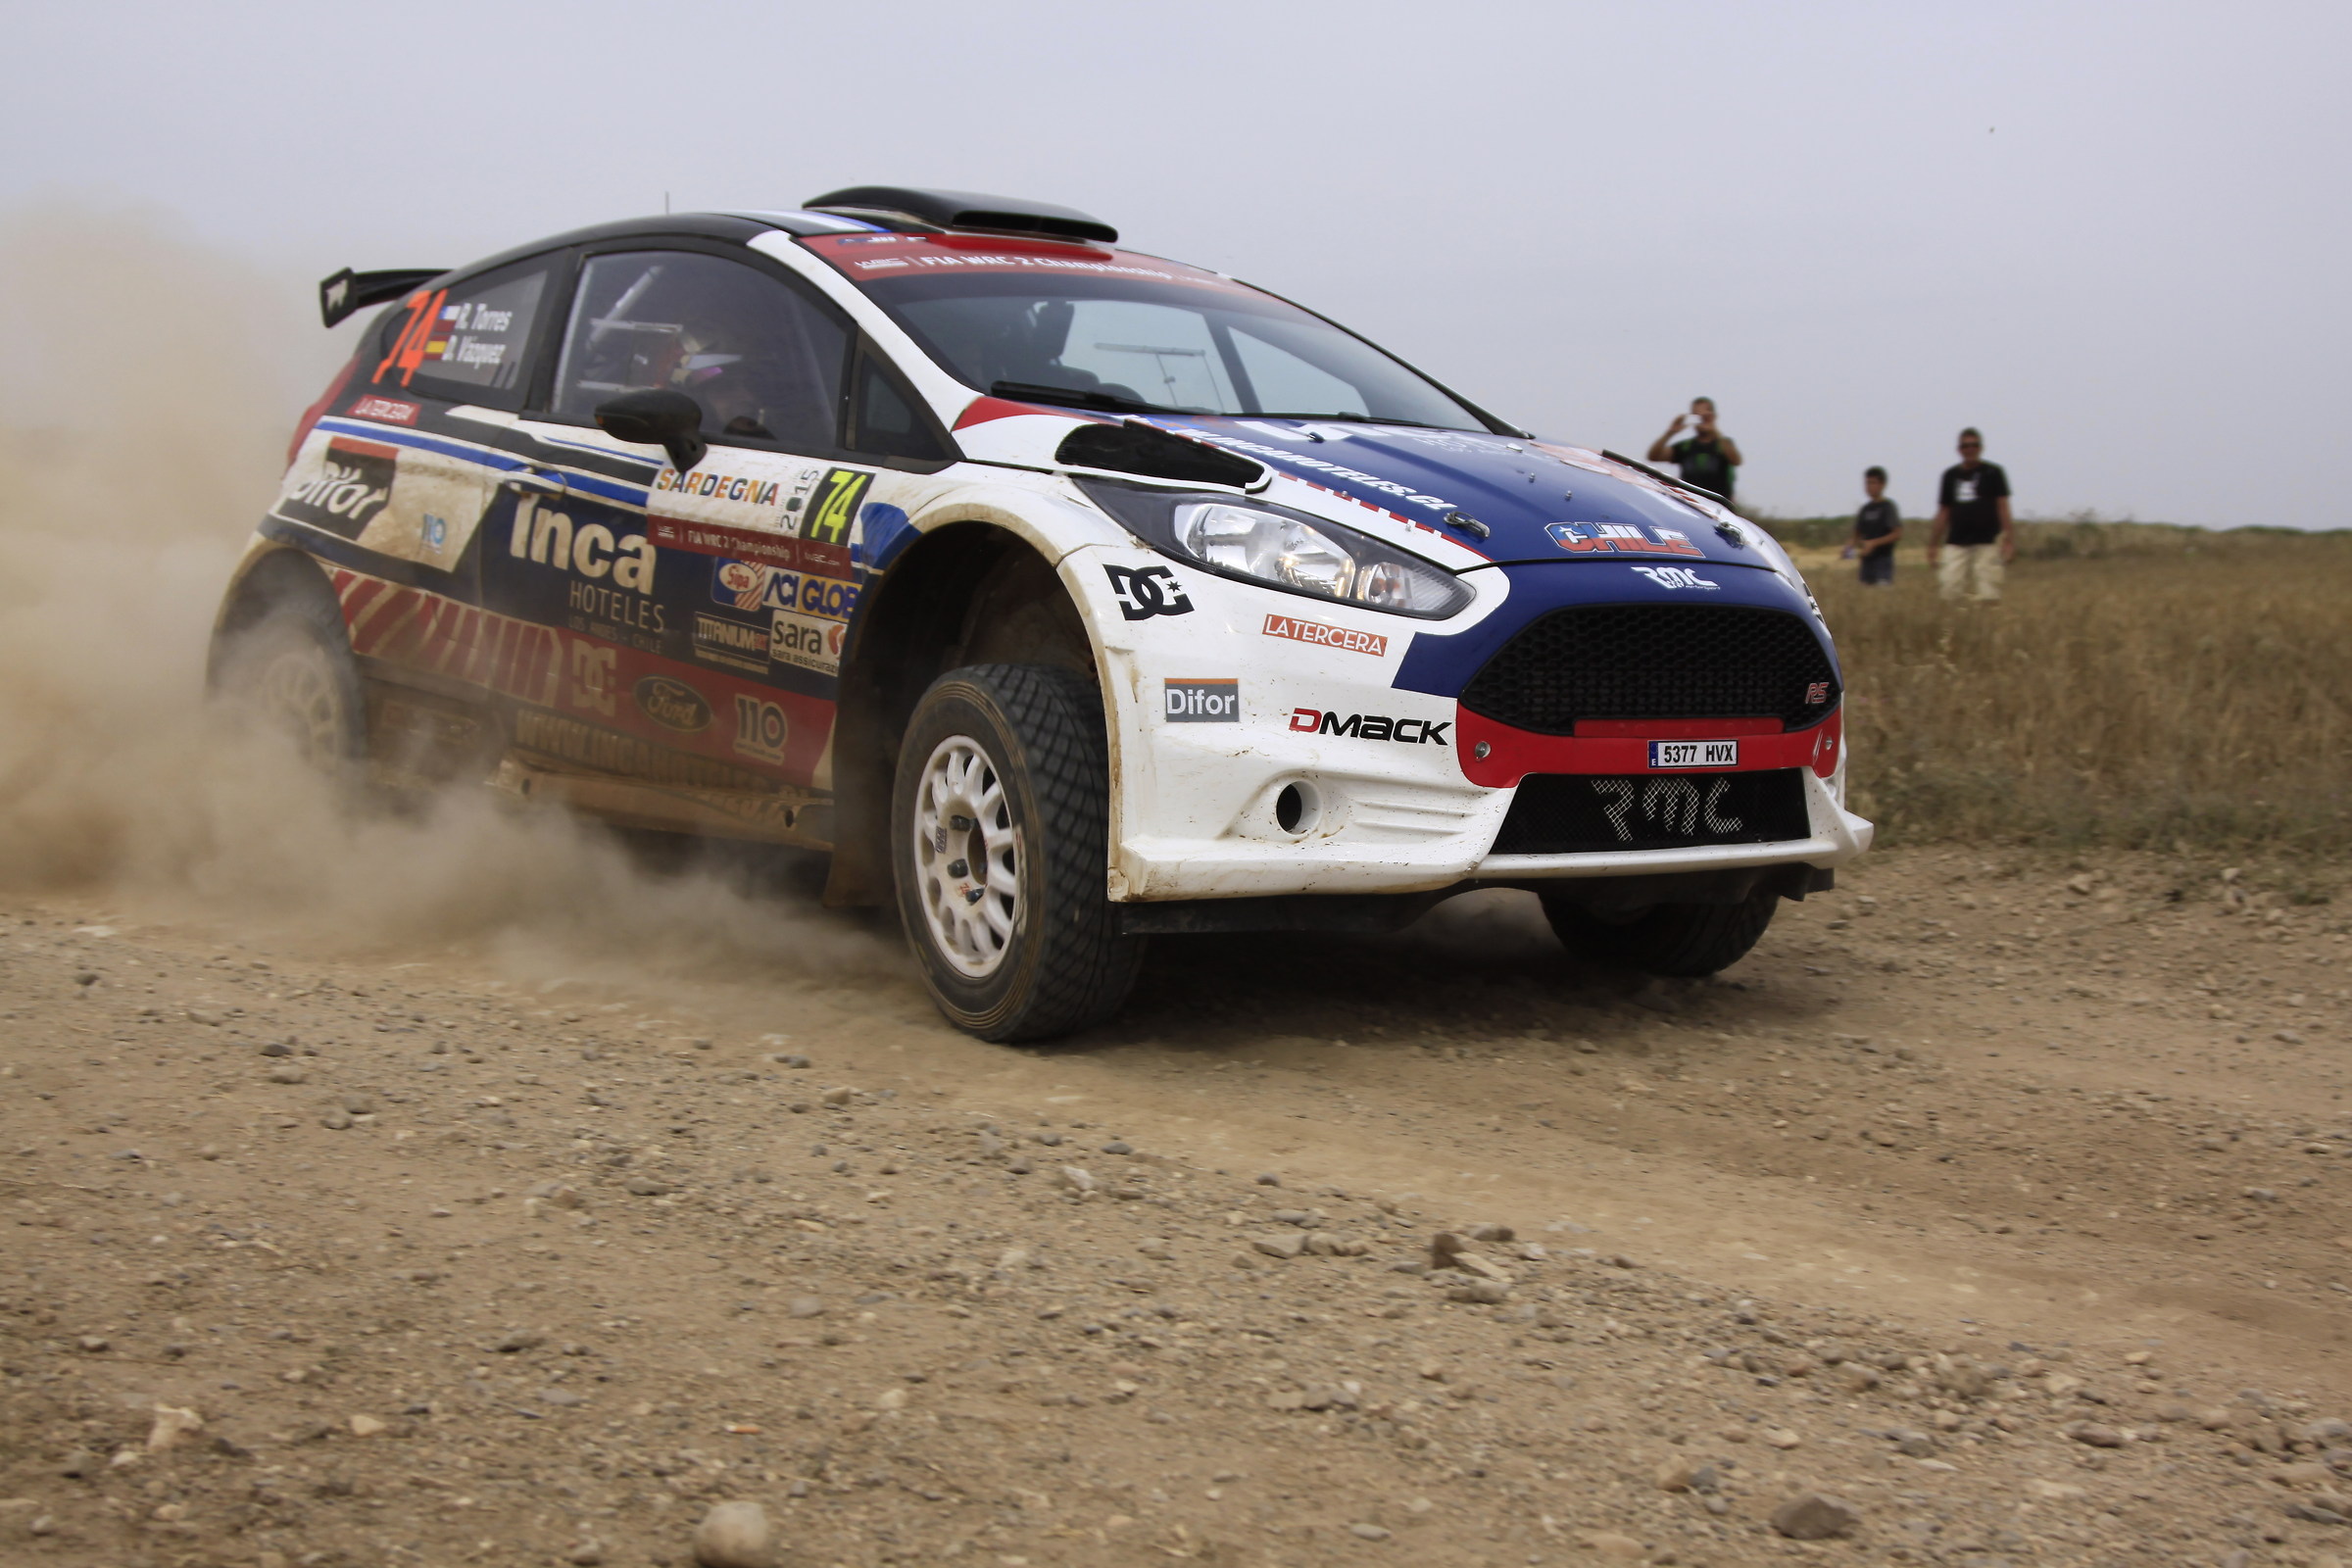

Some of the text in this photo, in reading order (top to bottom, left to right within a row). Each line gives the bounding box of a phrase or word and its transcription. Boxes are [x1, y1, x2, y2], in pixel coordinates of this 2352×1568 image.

[919, 256, 963, 266] FIA
[960, 256, 1015, 266] WRC
[1015, 257, 1034, 266] 2
[1033, 257, 1173, 280] Championship
[371, 288, 449, 388] 74
[657, 467, 780, 507] SARDEGNA
[810, 470, 868, 544] 74
[509, 492, 658, 596] Inca
[1544, 521, 1706, 559] CHILE
[569, 579, 664, 633] HOTELES
[1102, 563, 1195, 621] DC
[697, 616, 756, 652] TITANIUM
[772, 620, 822, 656] sara
[771, 648, 792, 662] sara
[647, 681, 699, 726] Ford
[1166, 688, 1236, 714] Difor
[1805, 682, 1829, 705] RS
[1664, 744, 1734, 763] 5377 HVX
